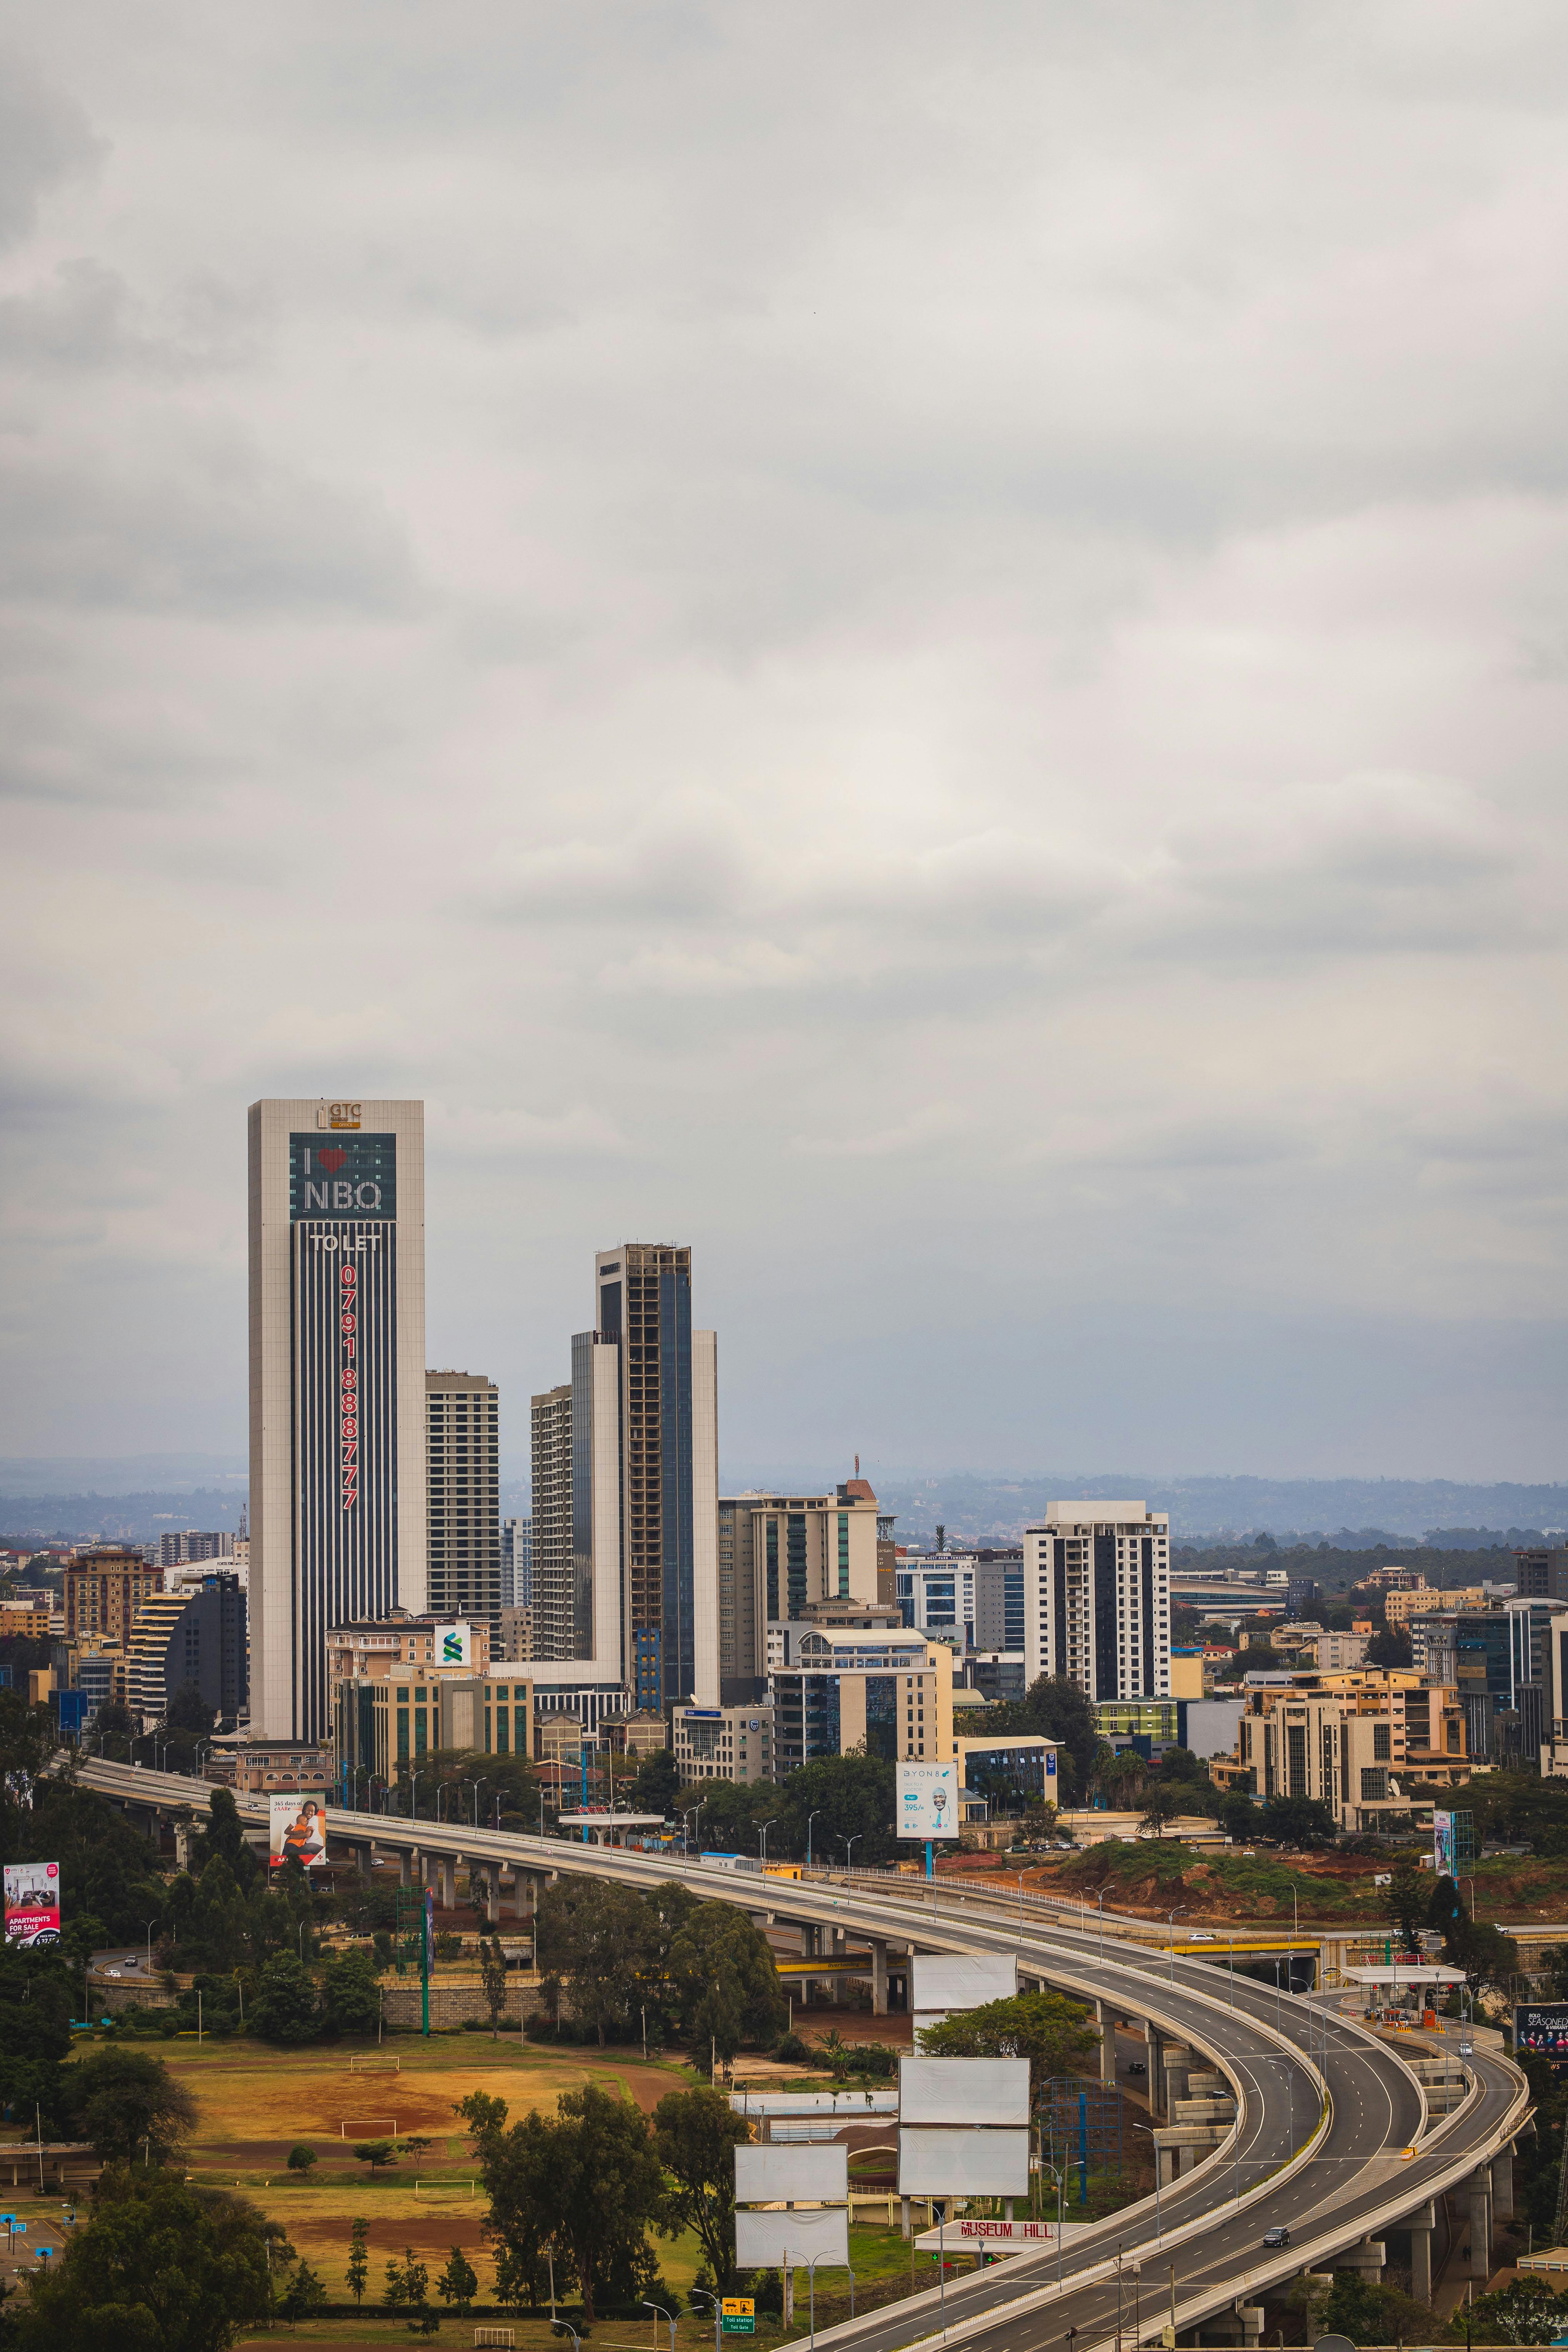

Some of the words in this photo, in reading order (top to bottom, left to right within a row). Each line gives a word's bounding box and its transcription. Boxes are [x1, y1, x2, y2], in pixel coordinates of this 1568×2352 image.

[330, 1103, 362, 1116] GTC
[304, 1181, 381, 1209] NBO
[310, 1235, 338, 1251] TO
[342, 1235, 380, 1251] LET
[9, 1916, 50, 1925] APARTMENTS
[1528, 2018, 1568, 2026] SEASONED
[961, 2222, 1012, 2237] MUSEUM
[1024, 2224, 1053, 2238] HILL
